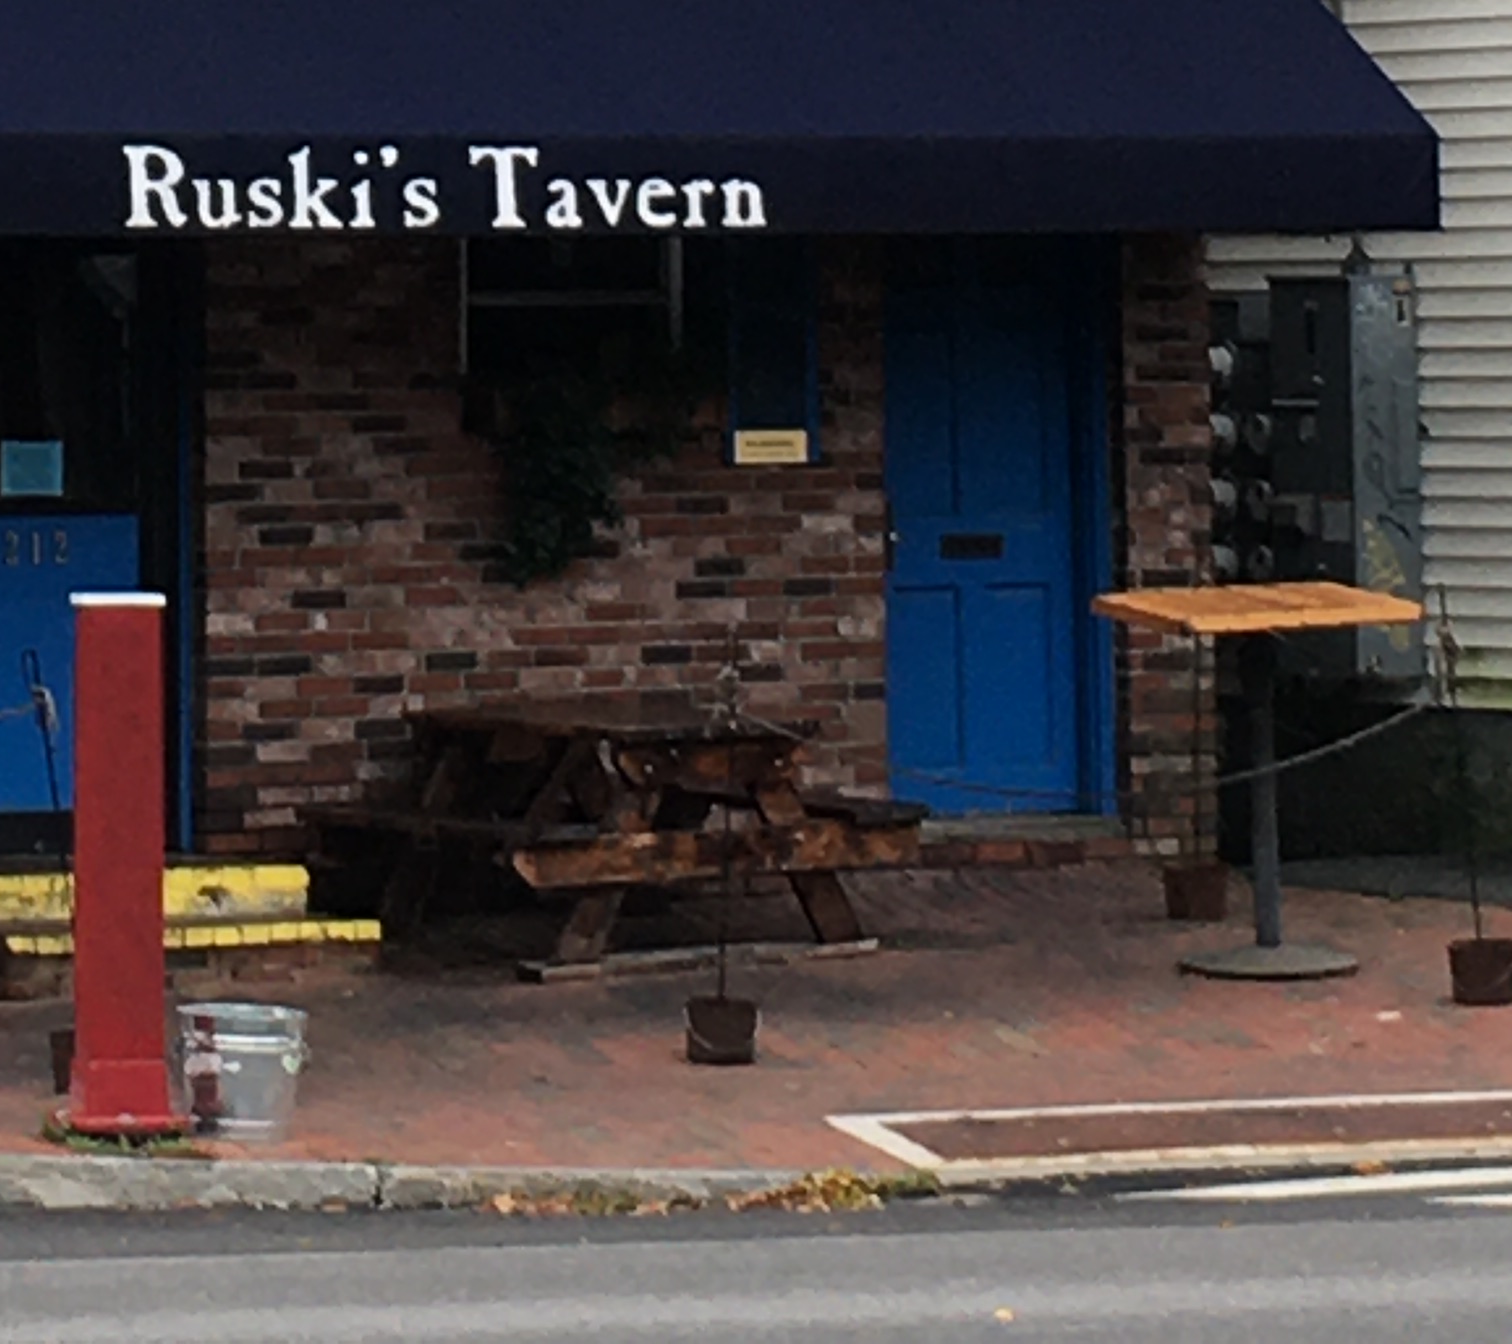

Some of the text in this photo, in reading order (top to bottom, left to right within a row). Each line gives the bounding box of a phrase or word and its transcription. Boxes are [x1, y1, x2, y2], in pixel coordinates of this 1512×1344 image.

[122, 144, 768, 230] Ruski's Tavern
[4, 529, 69, 566] 212
